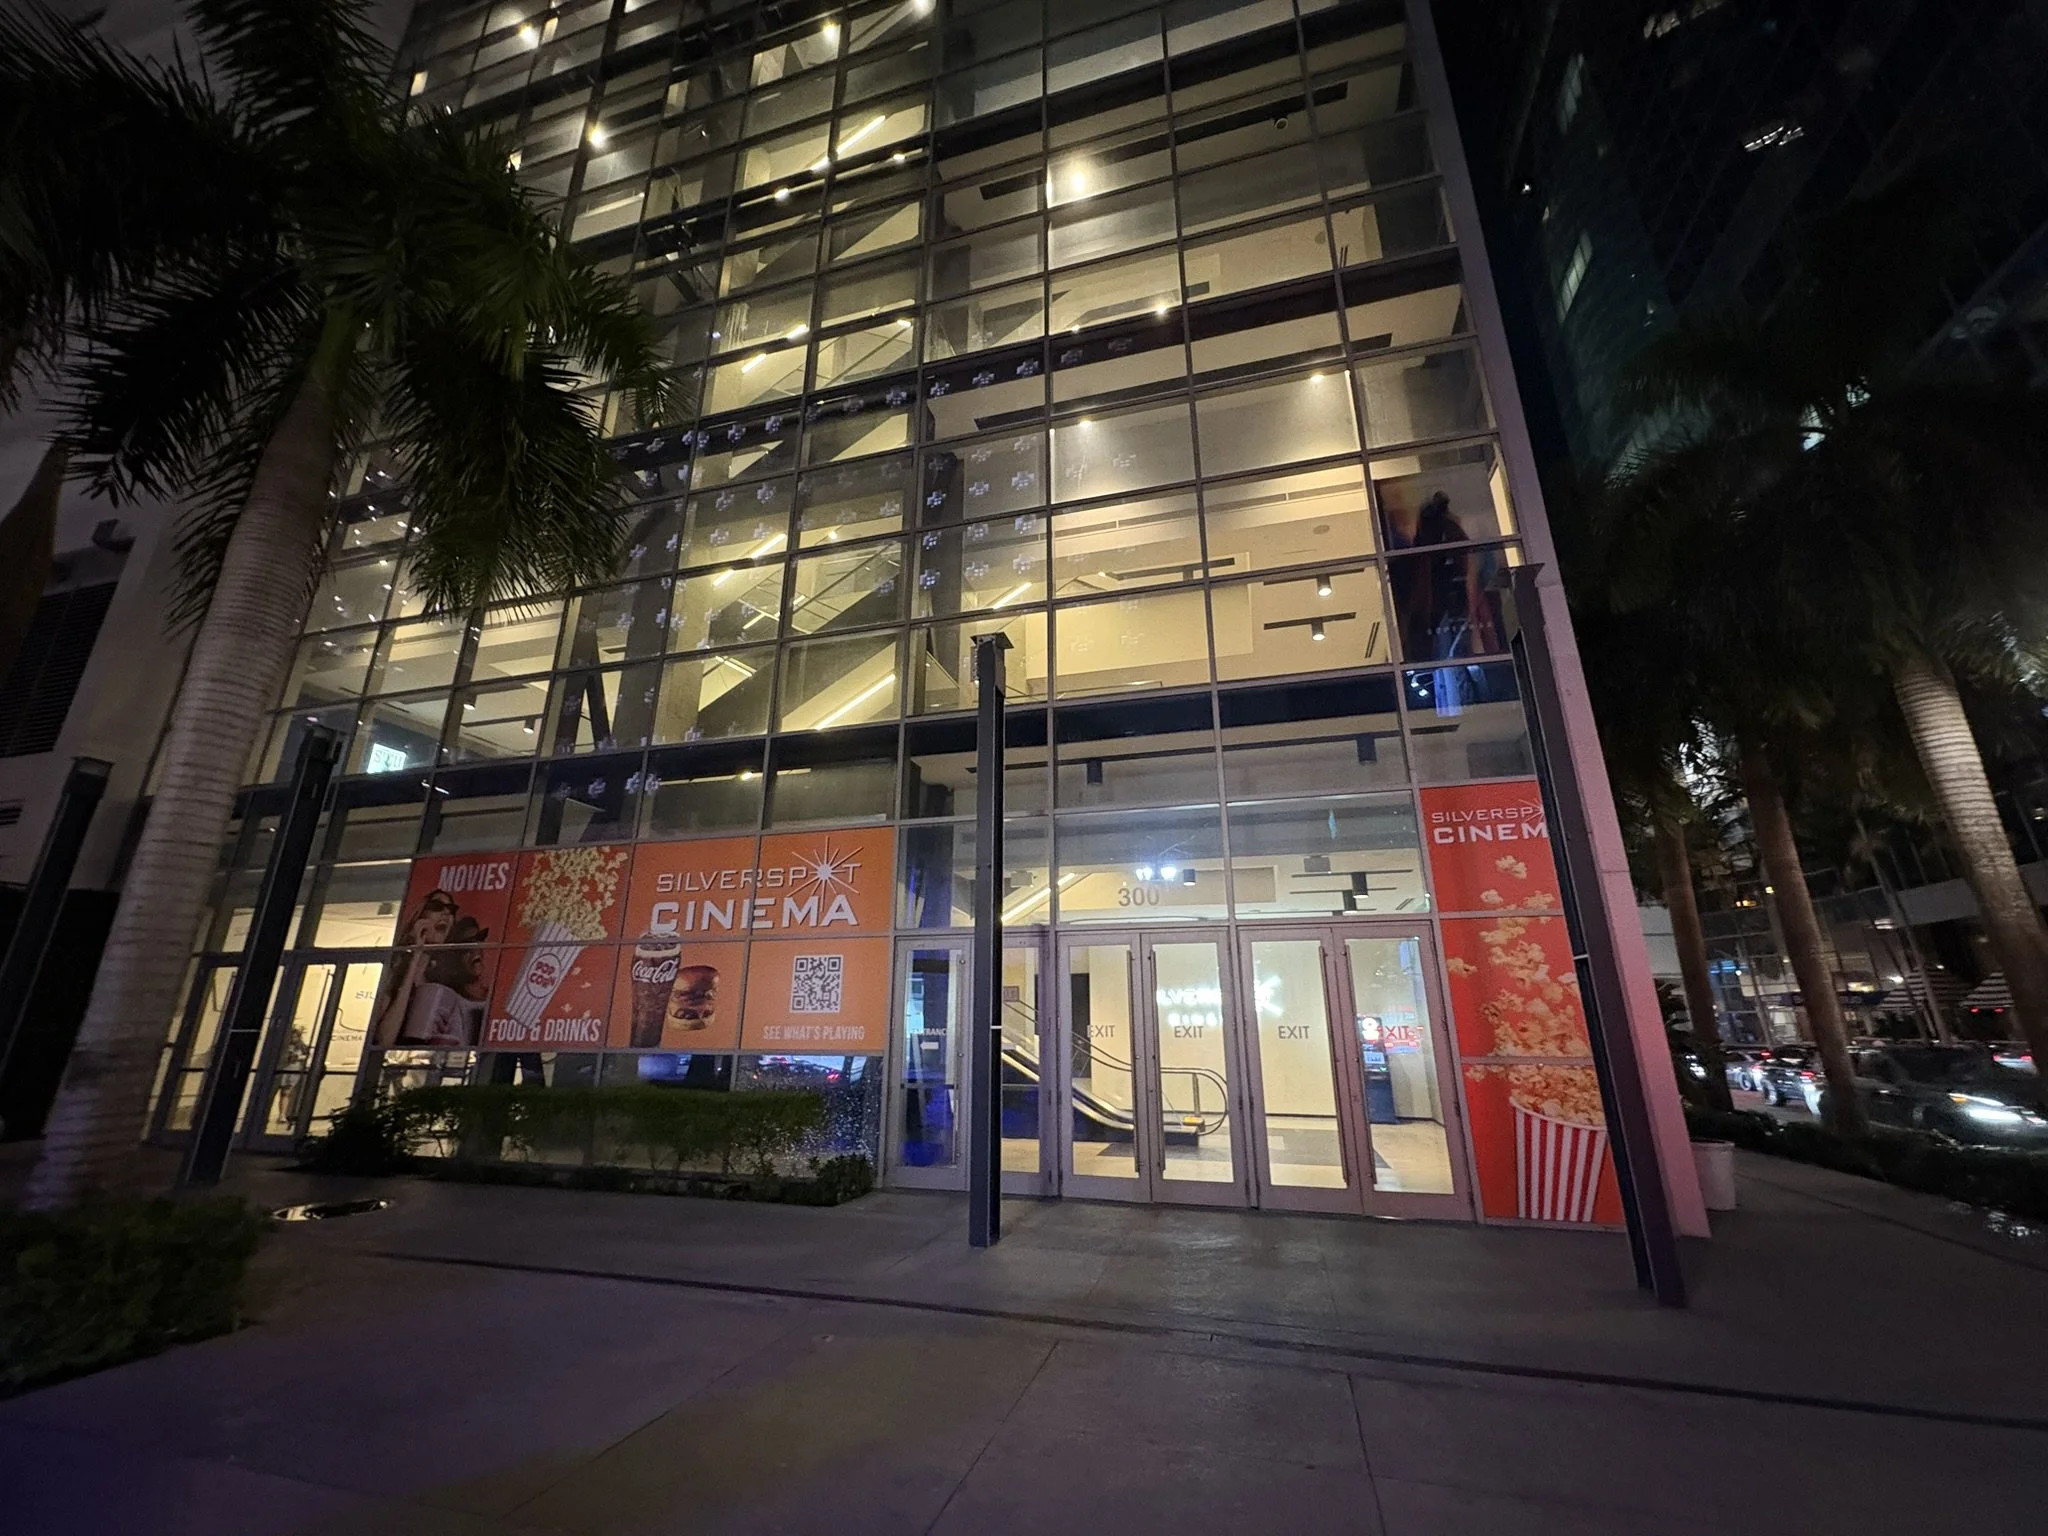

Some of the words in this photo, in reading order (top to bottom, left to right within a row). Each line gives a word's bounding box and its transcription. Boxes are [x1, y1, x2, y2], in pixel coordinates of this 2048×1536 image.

[1434, 823, 1548, 844] CINEM
[438, 863, 509, 891] MOVIES
[1118, 887, 1159, 907] 300
[650, 895, 858, 932] CINEMA
[535, 961, 556, 976] POP
[489, 1019, 526, 1042] FOOD
[530, 1020, 541, 1041] &
[544, 1018, 602, 1042] DRINKS
[763, 1026, 781, 1040] SEE
[822, 1025, 865, 1040] PLAYING
[1087, 1024, 1116, 1038] EXIT
[1174, 1025, 1205, 1039] EXIT
[1278, 1025, 1310, 1039] EXIT
